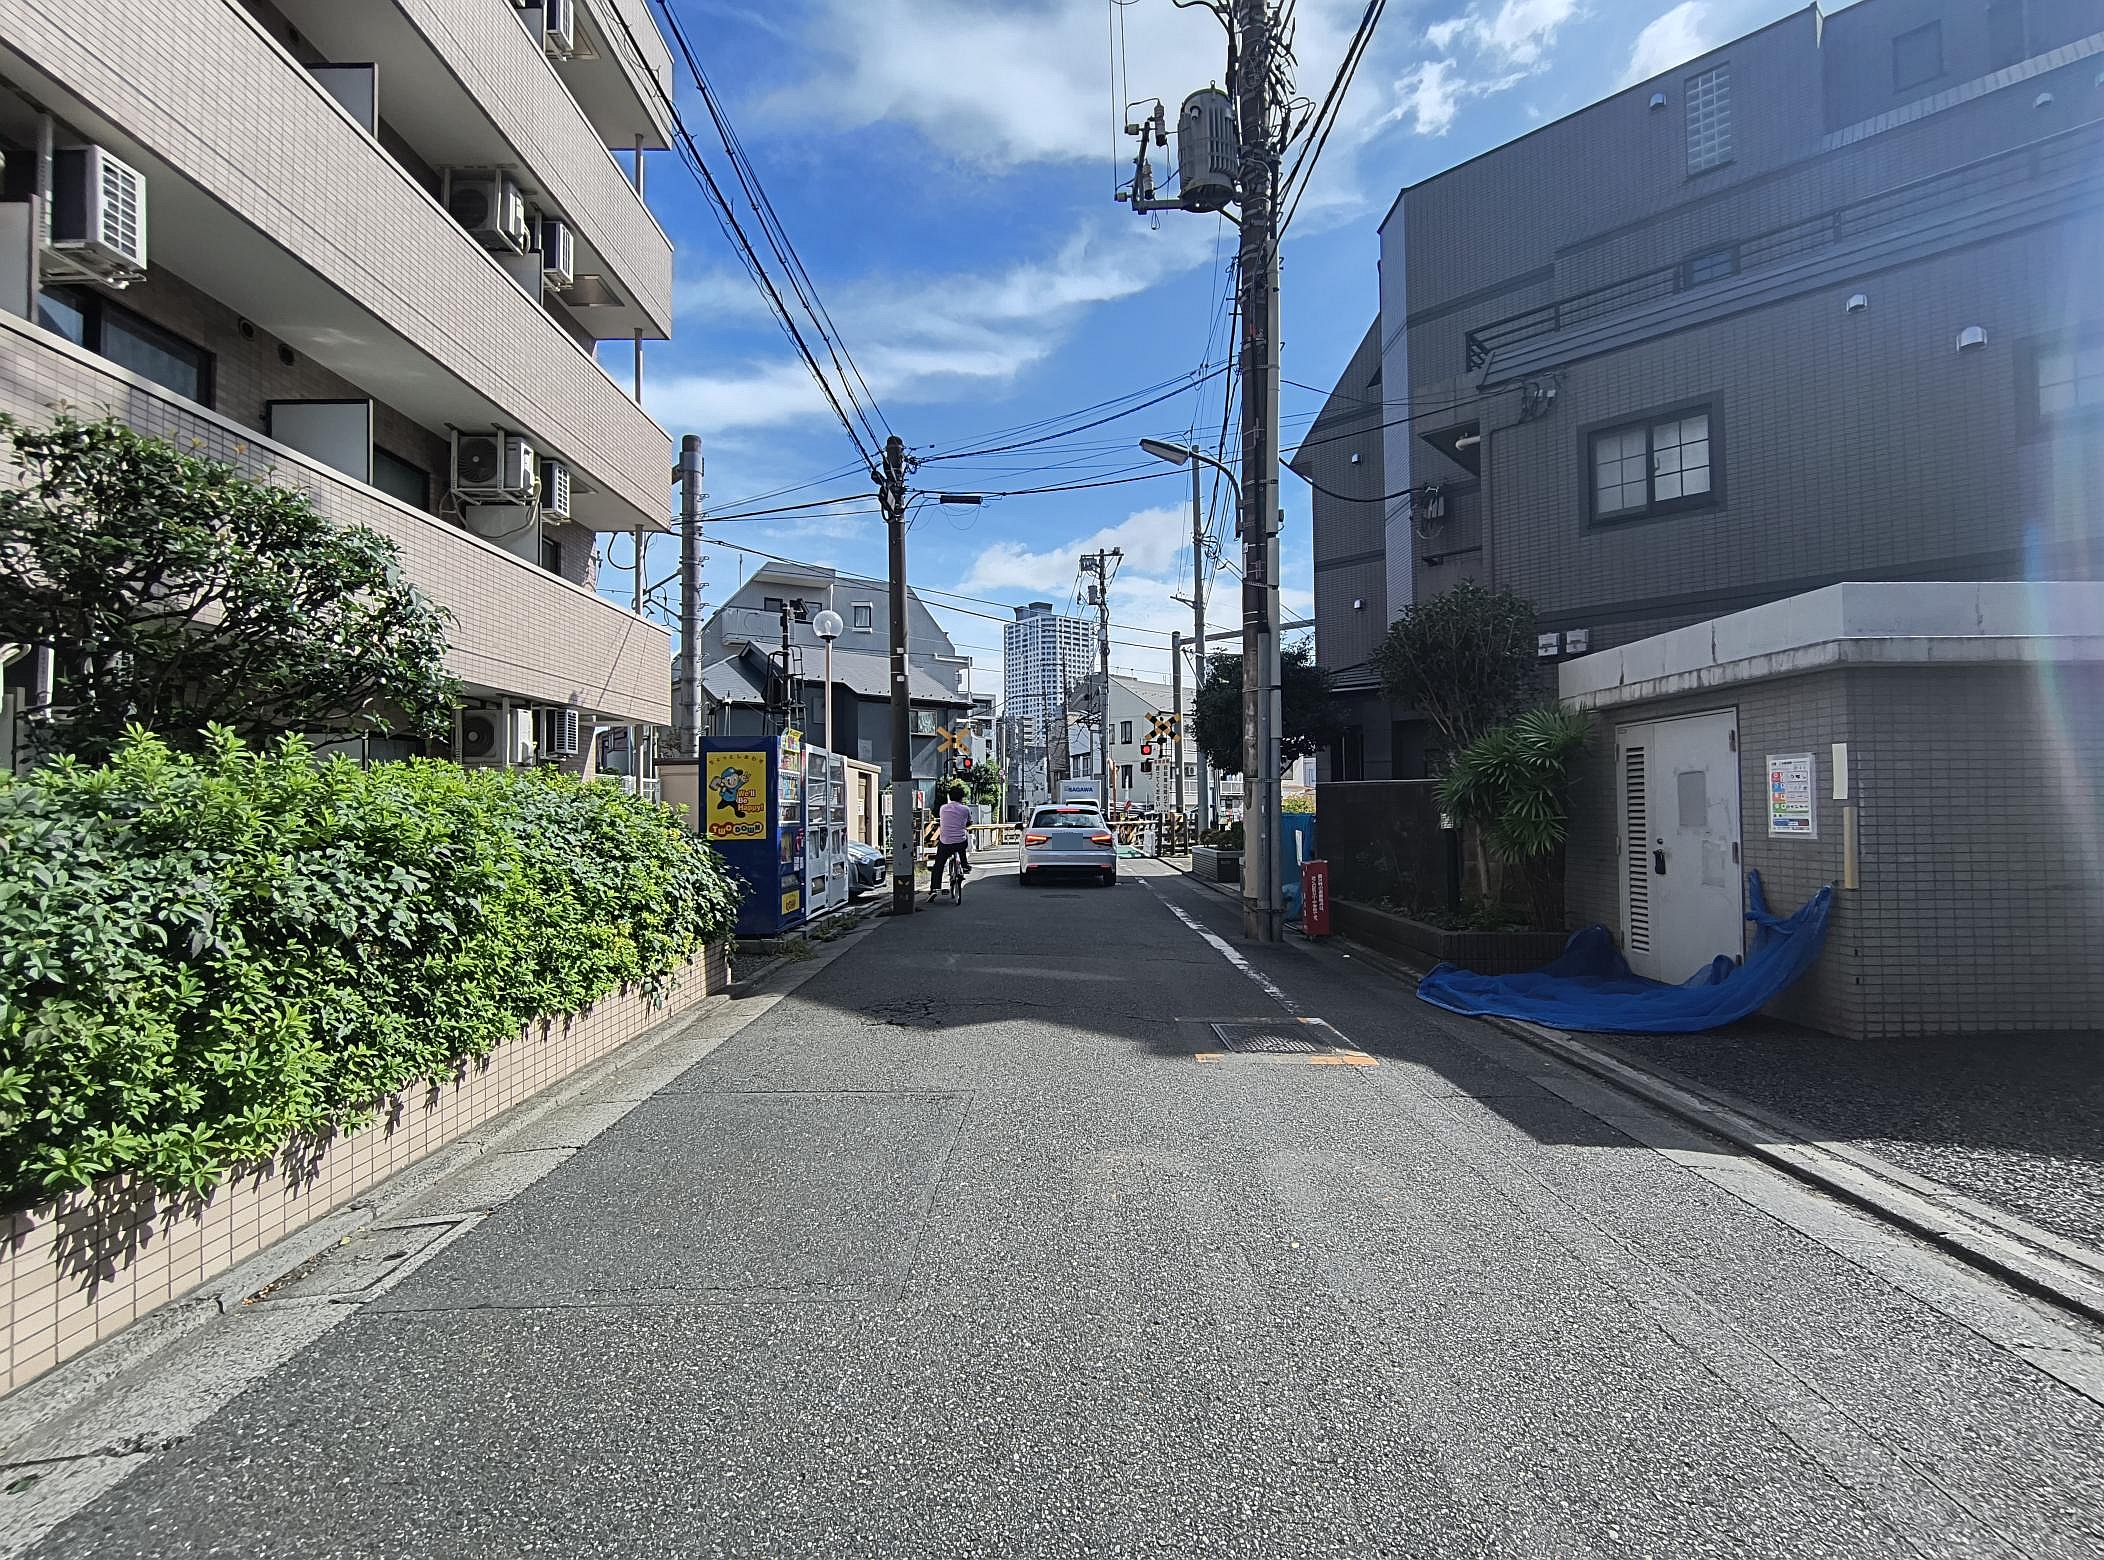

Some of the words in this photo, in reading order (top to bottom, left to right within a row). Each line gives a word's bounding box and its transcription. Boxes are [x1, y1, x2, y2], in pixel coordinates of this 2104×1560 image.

[737, 789, 757, 798] We'll
[737, 804, 765, 812] Happy!
[711, 823, 732, 836] TWO
[733, 822, 763, 835] DOWN
